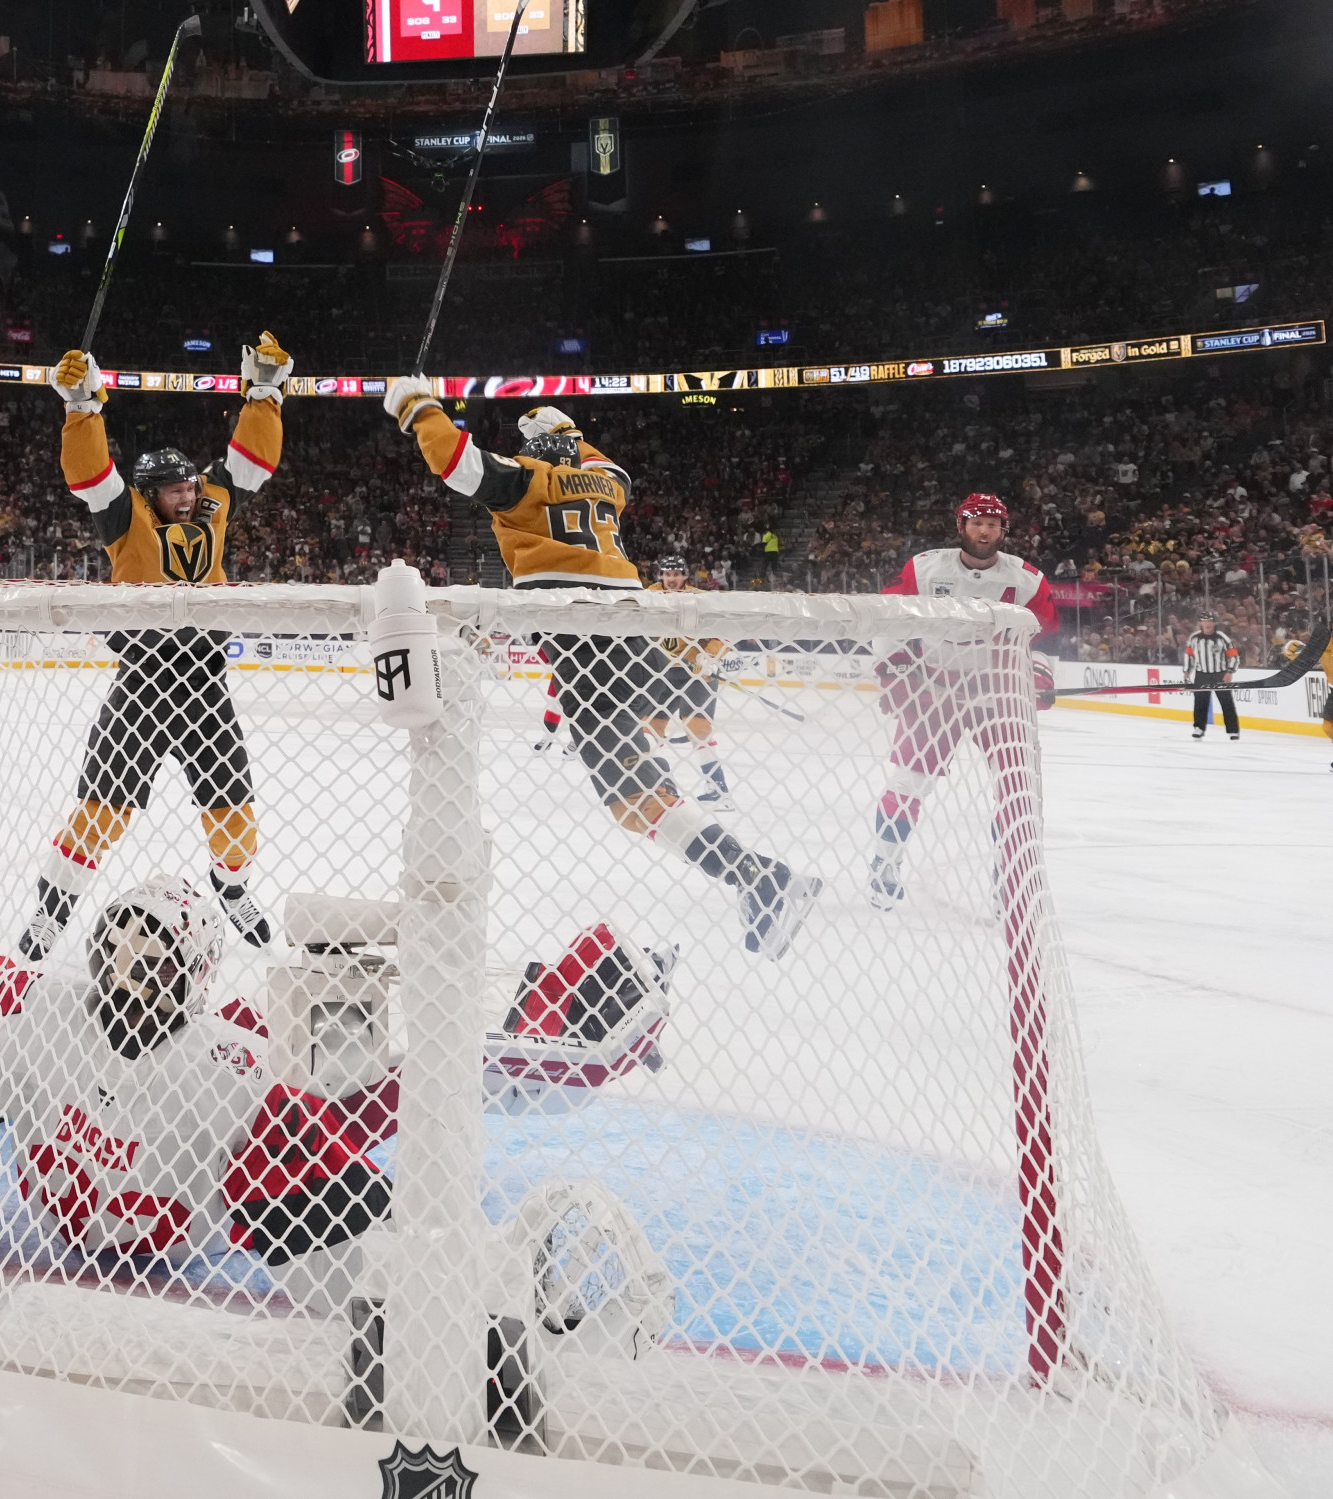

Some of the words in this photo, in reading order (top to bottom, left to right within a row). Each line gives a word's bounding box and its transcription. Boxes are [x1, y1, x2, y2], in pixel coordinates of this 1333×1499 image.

[415, 137, 451, 147] STANLEY
[453, 136, 470, 146] CUP
[184, 340, 211, 348] JAMESON
[1204, 337, 1241, 348] STANLEY
[1243, 334, 1259, 344] CUP
[1274, 331, 1301, 341] FINAL
[1072, 348, 1110, 364] Forged
[1127, 346, 1139, 357] in
[1141, 342, 1167, 355] Gold
[0, 369, 20, 378] HITS
[830, 365, 871, 383] 51/49
[871, 364, 906, 379] RAFFLE
[146, 375, 163, 387] 37
[217, 377, 238, 389] 1/2
[578, 376, 590, 392] 4
[594, 376, 628, 388] 14:22
[633, 376, 646, 391] 4
[559, 456, 572, 467] 93
[556, 474, 615, 500] MARNER
[431, 649, 442, 699] BODYARMOR
